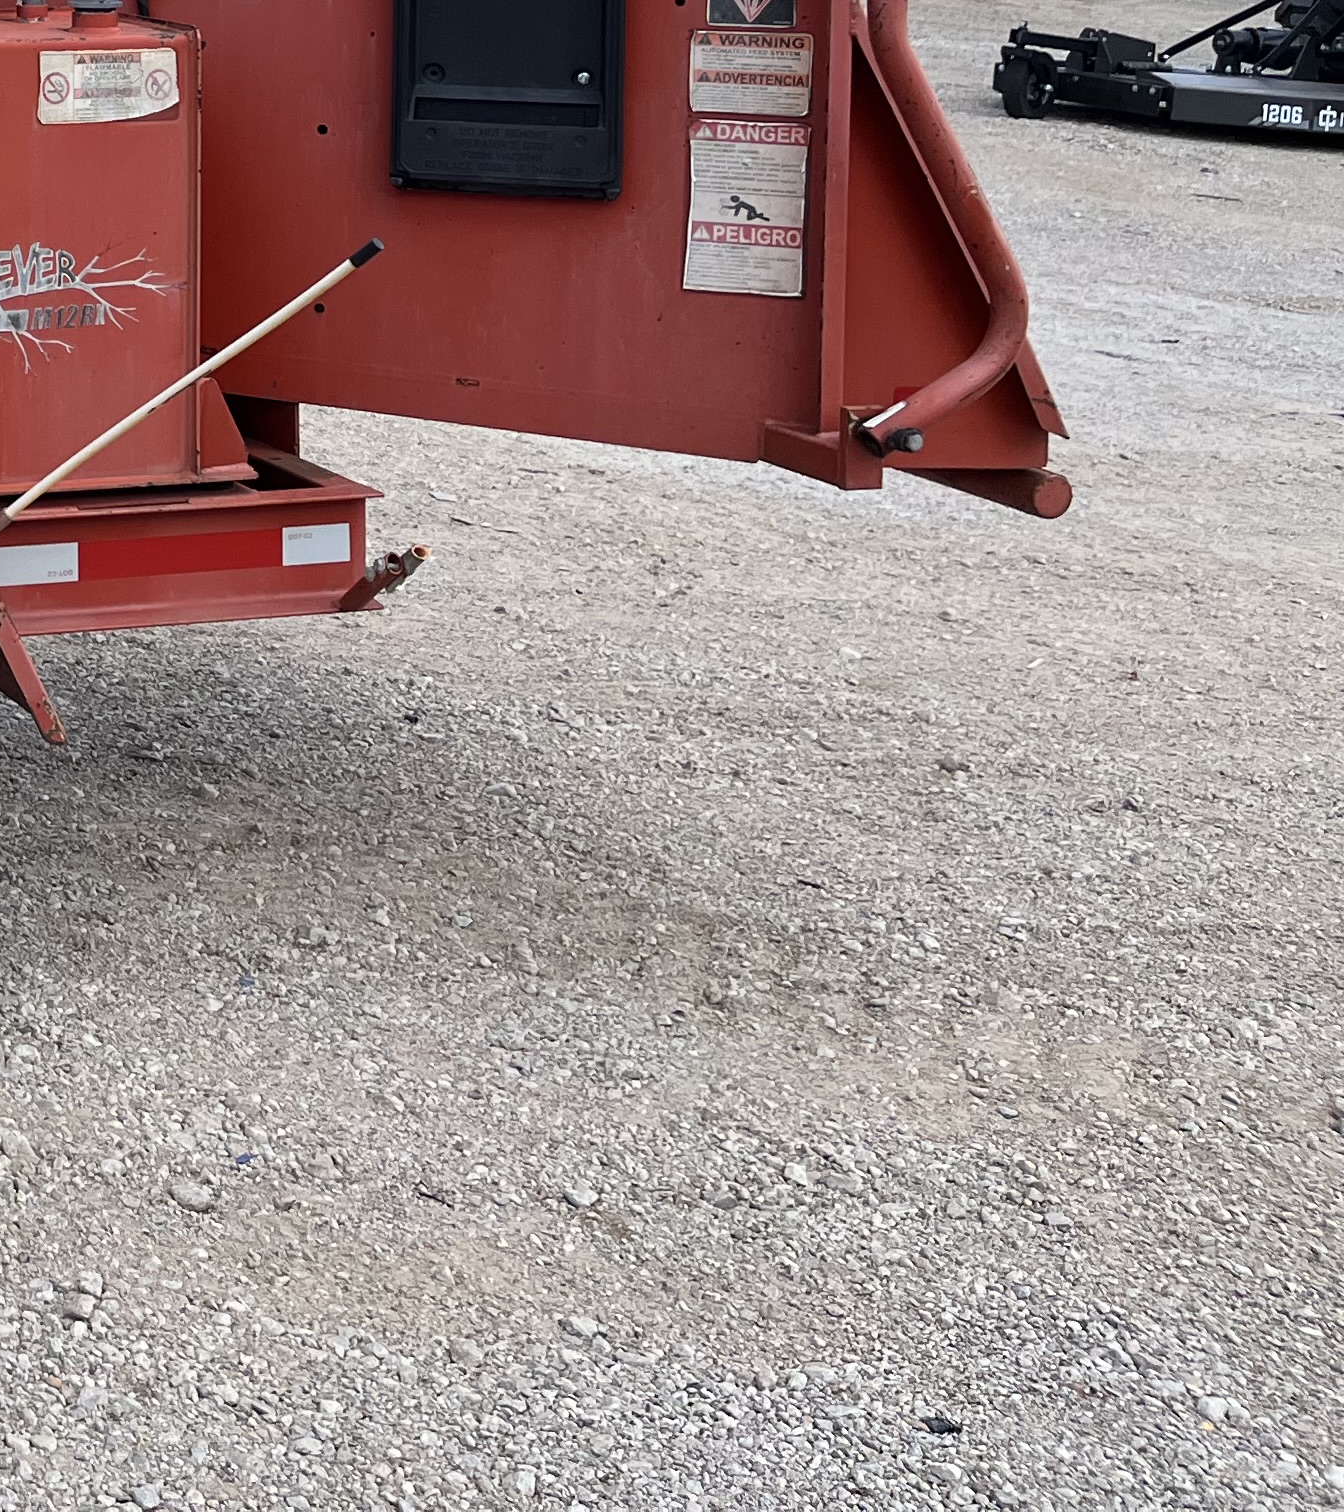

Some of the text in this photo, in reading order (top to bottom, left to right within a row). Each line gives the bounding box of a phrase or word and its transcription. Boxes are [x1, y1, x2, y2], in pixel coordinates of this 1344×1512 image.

[719, 34, 806, 49] WARNING
[713, 72, 805, 87] ADVERTENCIA
[1262, 103, 1303, 125] 1206
[716, 124, 805, 144] DANGER
[712, 224, 801, 247] PELIGRO
